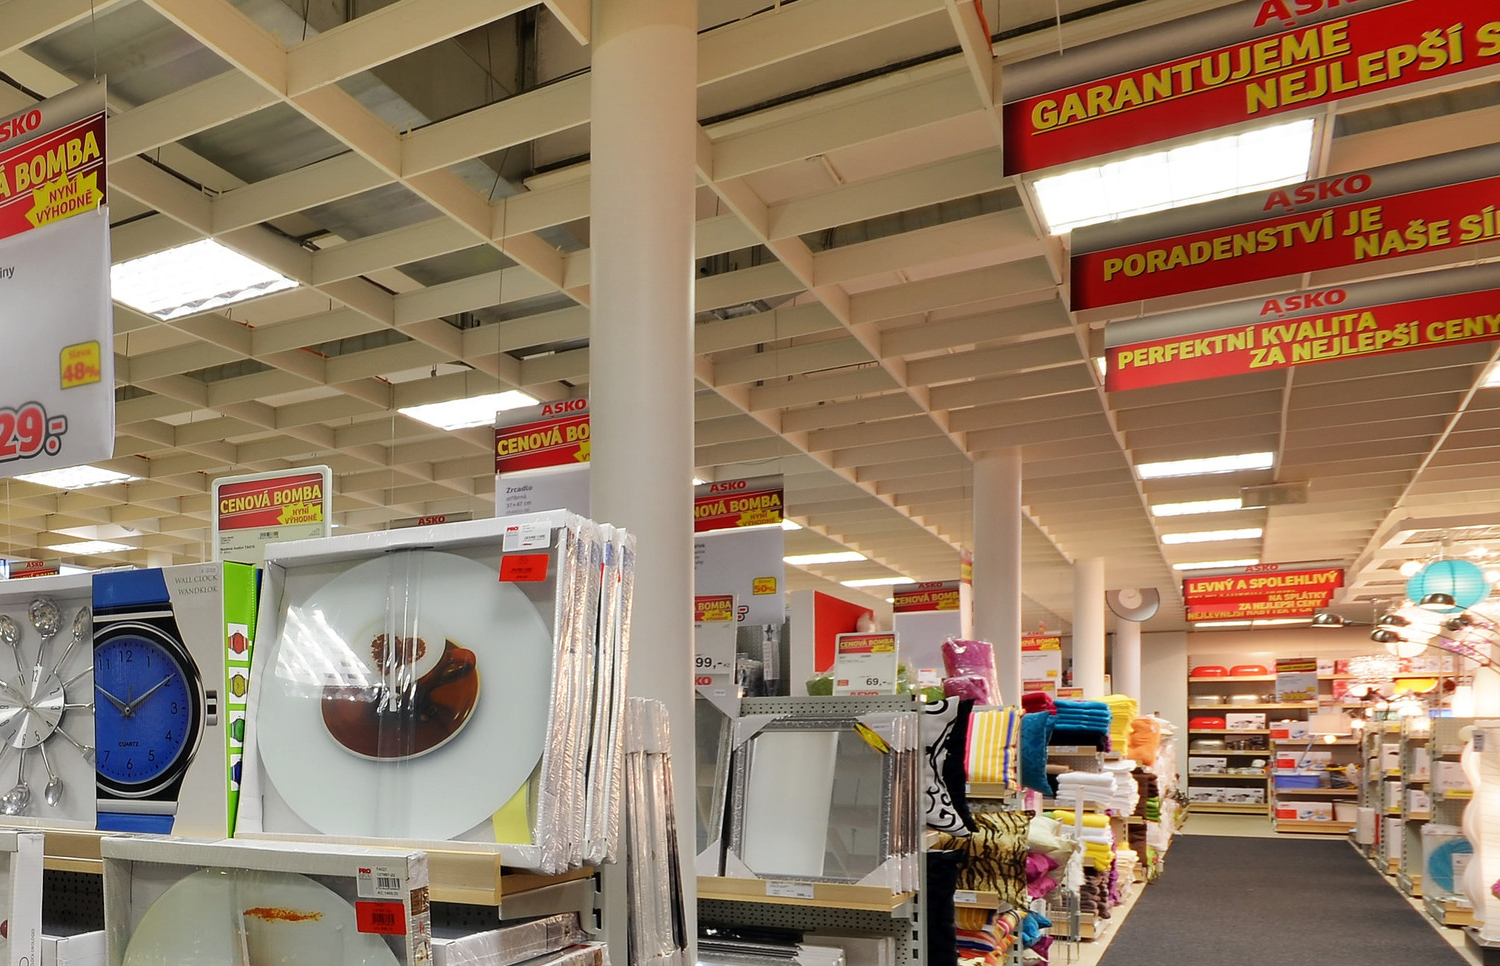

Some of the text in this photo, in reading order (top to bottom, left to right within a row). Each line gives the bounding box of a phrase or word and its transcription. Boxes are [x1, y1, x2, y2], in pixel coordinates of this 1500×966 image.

[1031, 20, 1351, 130] GARANTUJEME
[1246, 22, 1464, 114] NEJLEPŠÍ
[15, 131, 100, 191] BOMBA
[49, 179, 78, 203] NYNÍ
[1263, 174, 1373, 212] ASKO
[36, 191, 93, 224] VÝHODNĚ
[1354, 205, 1500, 260] NAŠE SÍ
[1104, 206, 1383, 281] PORADENSTVÍ JE
[1260, 289, 1347, 316] ASKO
[1118, 312, 1377, 369] PERFEKTNÍ KVALITA
[1249, 313, 1500, 368] ZA NEJLEPŠÍ CENY
[63, 362, 100, 383] 48%
[541, 398, 587, 418] ASKO
[498, 425, 563, 456] CENOVÁ
[506, 485, 532, 494] Zrcadlo
[710, 480, 747, 493] ASKO
[221, 485, 322, 514] CENOVÁ BOMBA
[730, 493, 780, 512] BOMBA
[285, 512, 318, 524] VÝHODNĚ
[292, 507, 309, 515] NYNÍ
[418, 515, 446, 527] ASKO
[1245, 563, 1279, 573] ASKO
[175, 574, 218, 584] WALL CLOCK
[1190, 570, 1338, 593] LEVNÝ A SPOLEHLIVÝ
[178, 585, 218, 595] WANDKLOK
[698, 601, 731, 611] BOMBA
[894, 593, 930, 606] CENOVÁ
[840, 638, 893, 648] CENOVÁ BOMBA
[119, 650, 132, 662] 12
[170, 703, 178, 714] 3
[165, 731, 173, 742] 4
[104, 750, 111, 762] 7
[148, 750, 155, 761] 5
[126, 758, 133, 770] 6
